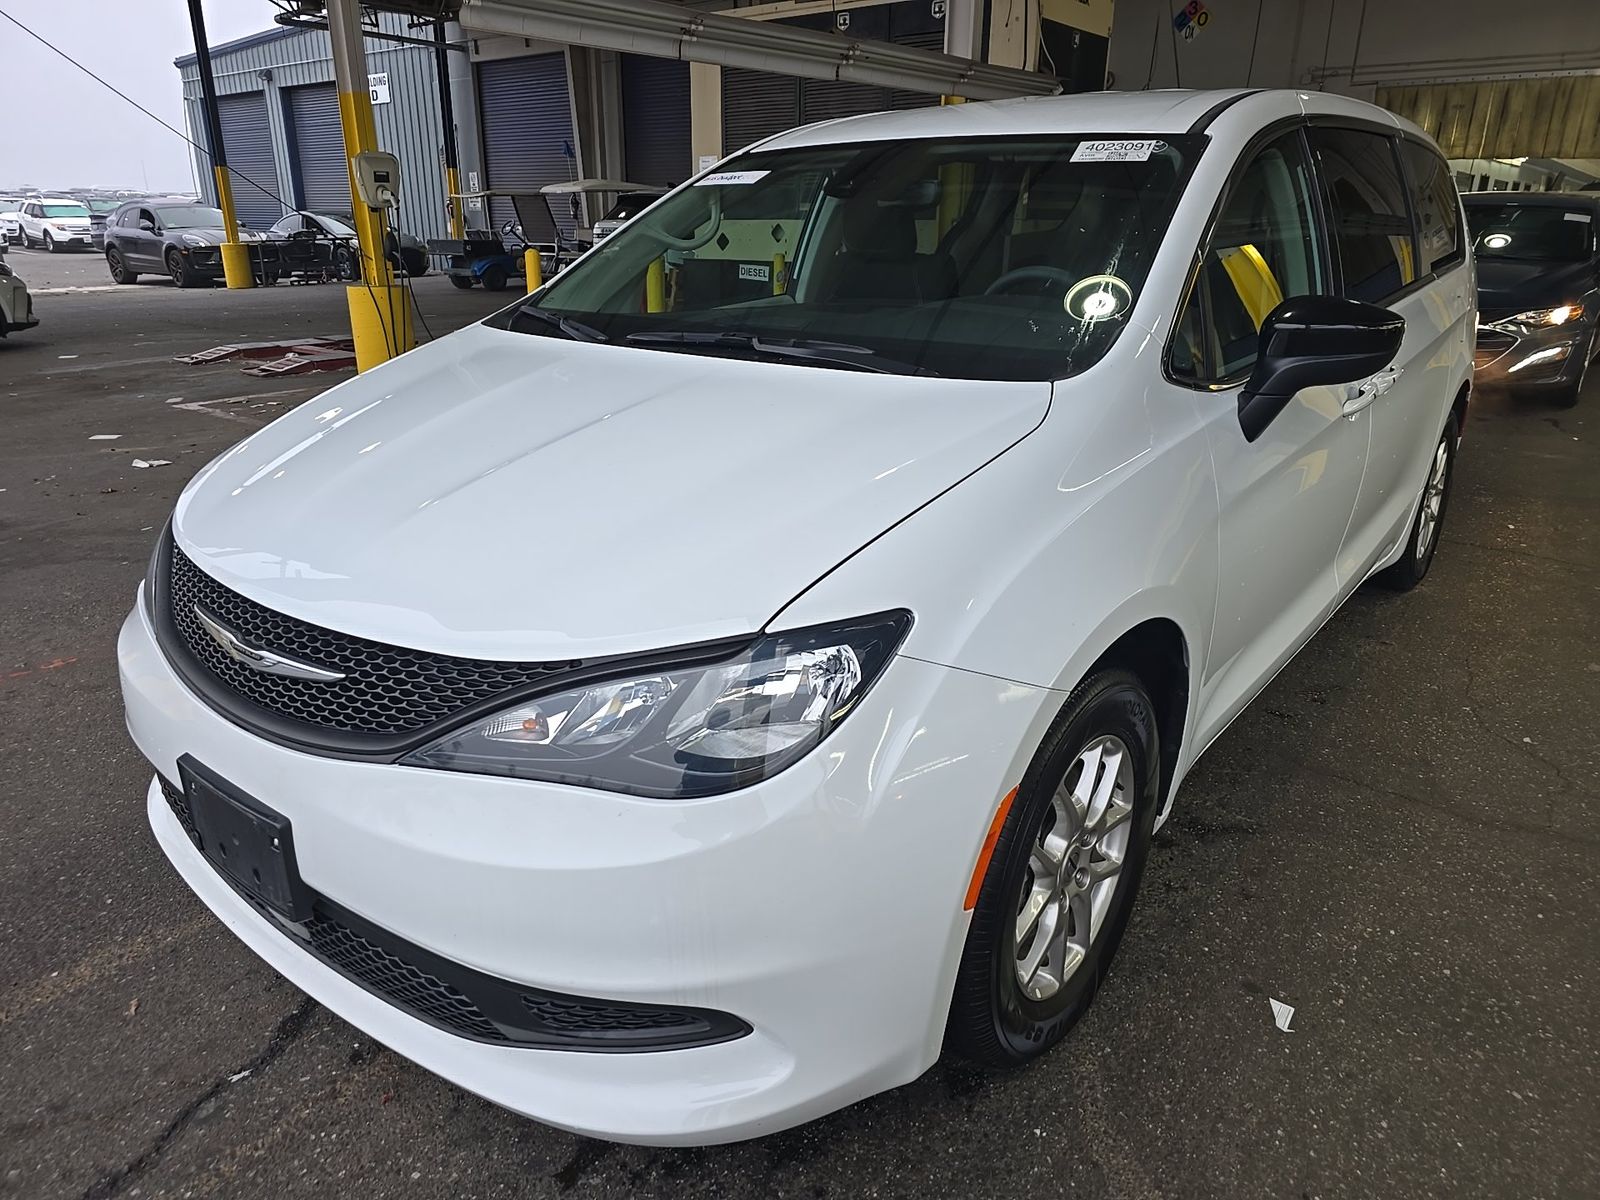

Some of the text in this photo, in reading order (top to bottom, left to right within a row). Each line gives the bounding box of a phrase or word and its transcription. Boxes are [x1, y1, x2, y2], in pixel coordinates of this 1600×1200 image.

[1188, 1, 1198, 15] 3
[371, 89, 379, 102] D
[1086, 142, 1153, 151] 4023091
[740, 266, 768, 278] DIESEL
